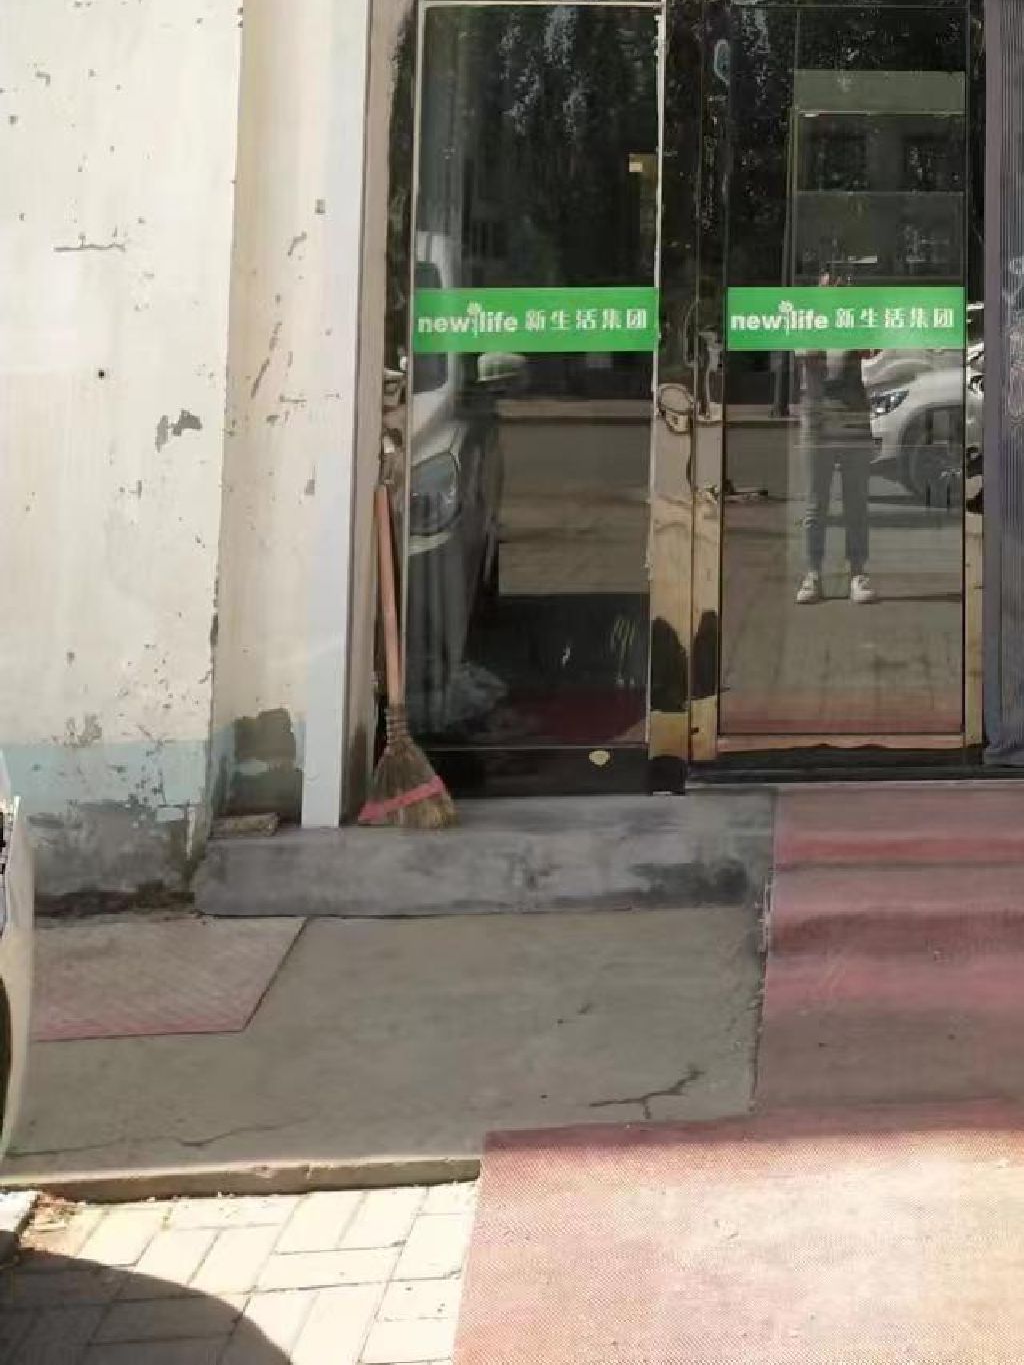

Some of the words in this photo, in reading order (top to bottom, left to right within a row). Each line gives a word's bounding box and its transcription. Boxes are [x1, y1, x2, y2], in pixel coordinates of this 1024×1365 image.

[524, 308, 647, 330] 新生活集团
[835, 307, 955, 329] 新生活集团
